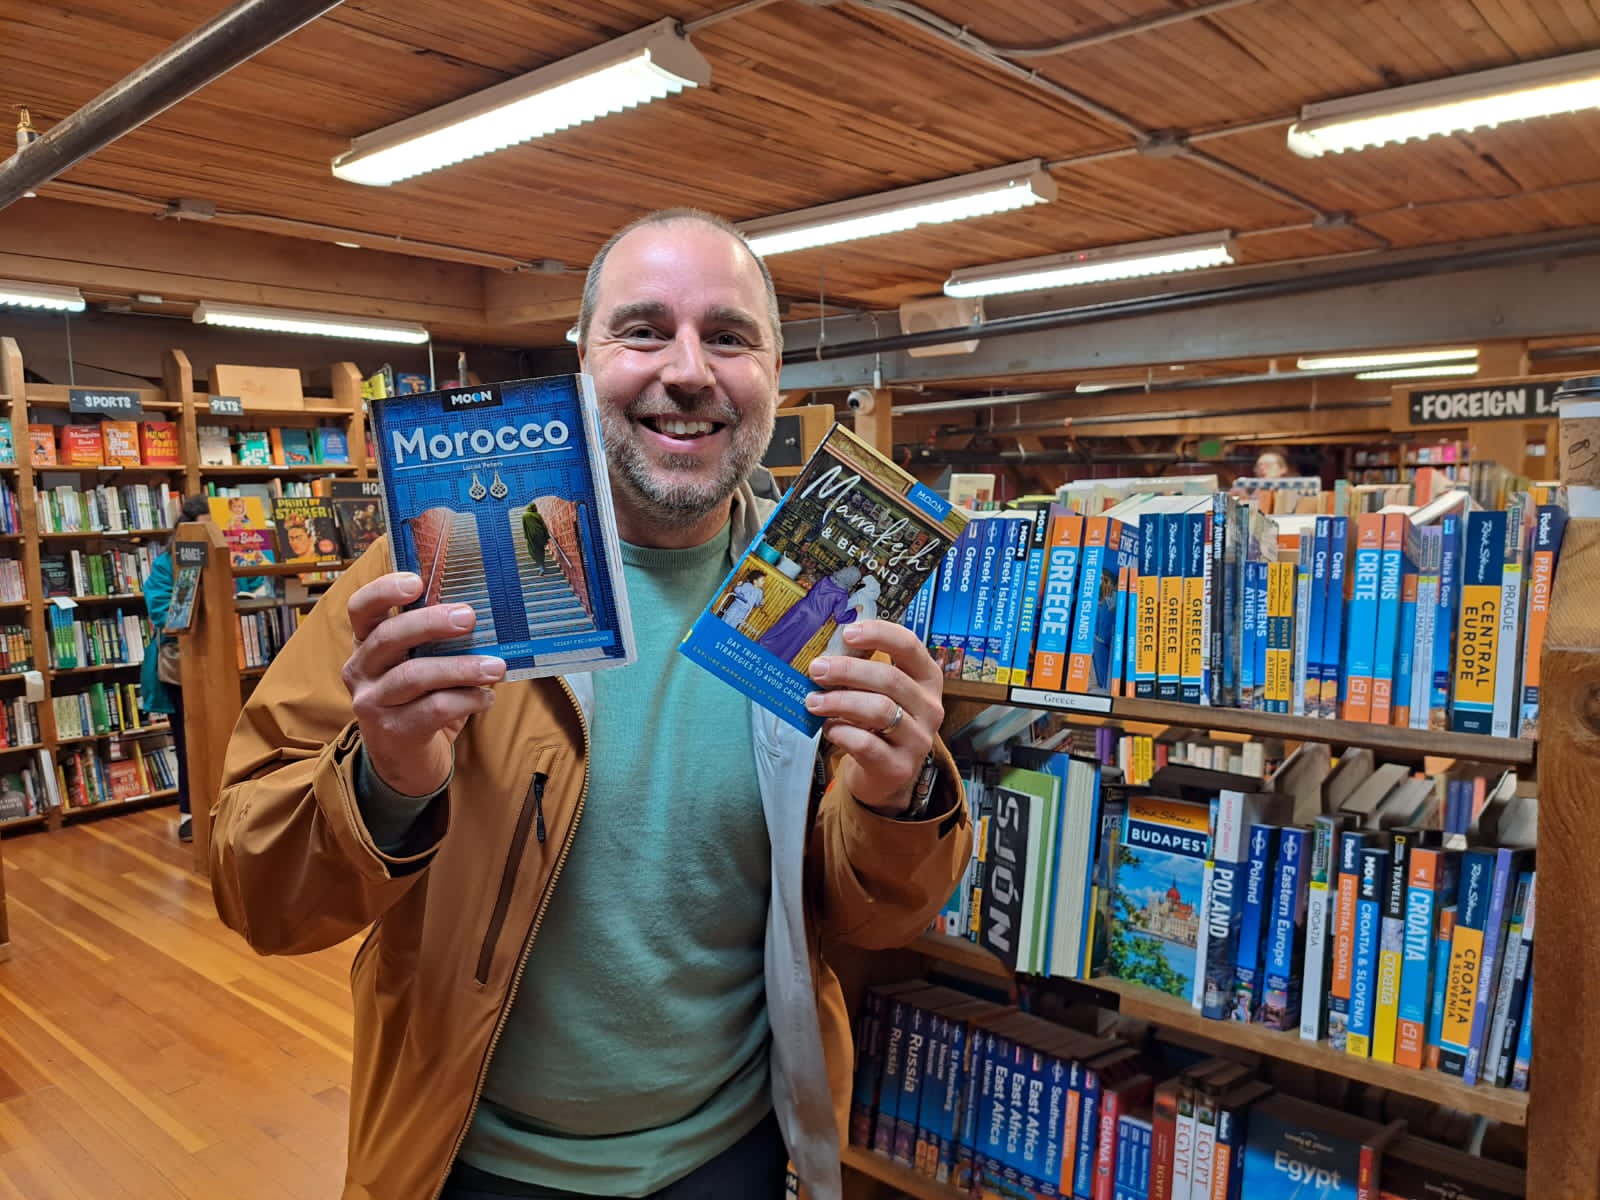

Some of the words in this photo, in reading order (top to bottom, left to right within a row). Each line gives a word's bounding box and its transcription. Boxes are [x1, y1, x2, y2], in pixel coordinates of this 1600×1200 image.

[84, 395, 132, 409] SPORTS
[212, 399, 239, 412] PETS
[451, 391, 492, 406] MOON
[1422, 389, 1526, 420] FOREIGN
[392, 420, 570, 464] Morocco
[916, 489, 944, 513] MOON
[1018, 525, 1029, 557] MOON
[1035, 510, 1046, 542] MOON
[1214, 526, 1224, 559] Athens
[1481, 520, 1492, 546] Rick
[1538, 512, 1552, 546] Fodor's
[822, 526, 833, 539] &
[836, 538, 899, 586] BEYOND
[943, 546, 957, 592] Greece
[960, 546, 976, 592] Greece
[981, 546, 995, 583] Greek
[1000, 546, 1016, 583] Greek
[1031, 552, 1041, 577] BEST
[1087, 549, 1099, 566] THE
[1315, 551, 1326, 579] Crete
[1332, 551, 1343, 580] Crete
[1356, 552, 1379, 600] CRETE
[1381, 552, 1399, 600] CYPRUS
[1443, 551, 1452, 575] Malta
[1478, 547, 1490, 582] Steves
[1027, 581, 1036, 595] OF
[1042, 550, 1075, 636] GREECE
[1083, 566, 1097, 599] GREEK
[1440, 585, 1450, 608] Gozo
[1533, 557, 1550, 612] PRAGUE
[918, 588, 928, 624] GREECE
[974, 586, 990, 630] Islands
[994, 587, 1009, 631] Islands
[1020, 596, 1035, 633] GREECE
[1077, 600, 1092, 641] ISLANDS
[1144, 596, 1154, 652] GREECE
[1168, 597, 1178, 654] GREECE
[1191, 598, 1202, 655] GREECE
[1244, 587, 1255, 630] ATHENS
[1257, 589, 1268, 637] ATHENS
[1502, 584, 1516, 631] PRAGUE
[1002, 631, 1011, 661] ATHENS
[1460, 606, 1478, 681] EUROPE
[1476, 600, 1495, 687] CENTRAL
[715, 641, 753, 671] STRATEGIES
[754, 667, 763, 677] TO
[763, 674, 783, 690] AVOID
[783, 687, 806, 705] CROWD
[764, 662, 784, 680] LOCAL
[1044, 695, 1076, 706] Greece
[1131, 828, 1207, 855] BUDAPEST
[988, 796, 1019, 952] SJÓN
[1247, 858, 1263, 904] Poland
[1279, 865, 1296, 916] Eastern
[1363, 856, 1376, 896] MOON
[1390, 865, 1403, 914] TRAVELER
[1208, 867, 1234, 938] POLAND
[1311, 900, 1322, 947] CROATIA
[1340, 878, 1352, 934] ESSENTIAL
[1273, 919, 1291, 968] Europe
[1359, 904, 1372, 955] CROATIA
[1405, 890, 1429, 961] CROATIA
[1337, 936, 1349, 981] CROATIA
[1359, 957, 1368, 967] &
[1353, 969, 1368, 1028] SLOVENIA
[1447, 964, 1461, 1018] SLOVENIA
[1456, 949, 1476, 1025] CROATIA
[887, 1026, 902, 1075] Russia
[904, 1033, 924, 1094] Russia
[994, 1065, 1008, 1102] East
[1011, 1072, 1025, 1107] East
[1028, 1080, 1043, 1114] East
[990, 1101, 1005, 1145] Africa
[1007, 1108, 1022, 1153] Africa
[1048, 1086, 1062, 1138] Southern
[1081, 1097, 1094, 1141] Botswana
[1024, 1115, 1040, 1161] Africa
[1045, 1140, 1057, 1175] Africa
[1099, 1115, 1113, 1162] GHANA
[1176, 1122, 1192, 1181] EGYPT
[1195, 1130, 1213, 1191] EGYPT
[1274, 1149, 1341, 1190] Egypt
